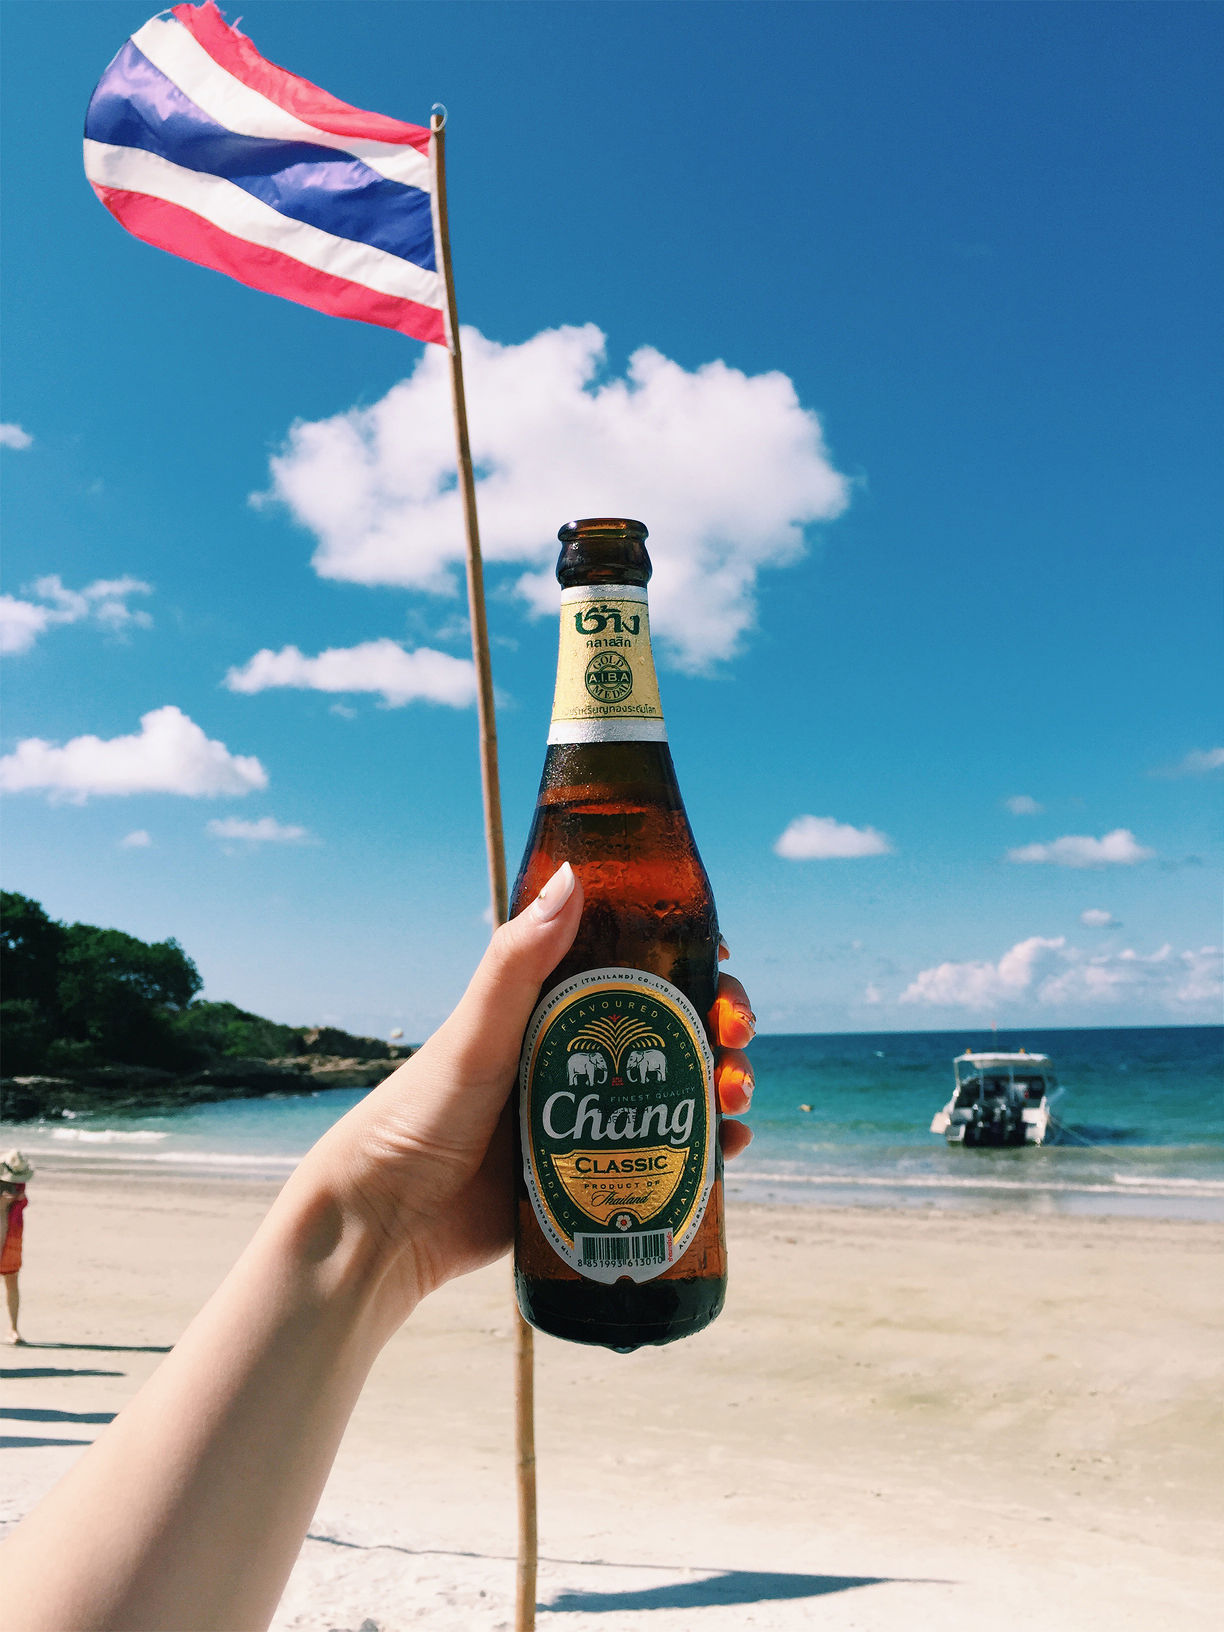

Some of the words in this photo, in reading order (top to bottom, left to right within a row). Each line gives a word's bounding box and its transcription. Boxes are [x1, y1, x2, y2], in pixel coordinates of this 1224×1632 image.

[574, 605, 640, 635] ช้าง
[586, 636, 631, 648] คลาสสิก
[593, 655, 624, 669] GOLD
[592, 685, 628, 699] MEDAL
[547, 983, 579, 1009] BREWERY
[581, 974, 634, 985] (THAILAND)
[540, 1040, 558, 1078] FULL
[561, 1000, 658, 1032] FLAVOURED
[666, 1023, 695, 1071] LAGER
[610, 1094, 650, 1102] FINEST
[655, 1086, 695, 1099] QUALITY
[541, 1091, 695, 1145] Chang
[575, 1155, 668, 1174] CLASSIC
[540, 1149, 560, 1199] PRIDE
[563, 1211, 578, 1227] OF
[667, 1141, 700, 1225] THAILAND
[584, 1182, 640, 1190] PRODUCT
[591, 1190, 654, 1207] Thailand
[587, 1260, 622, 1268] 851993
[627, 1256, 663, 1267] 613010
